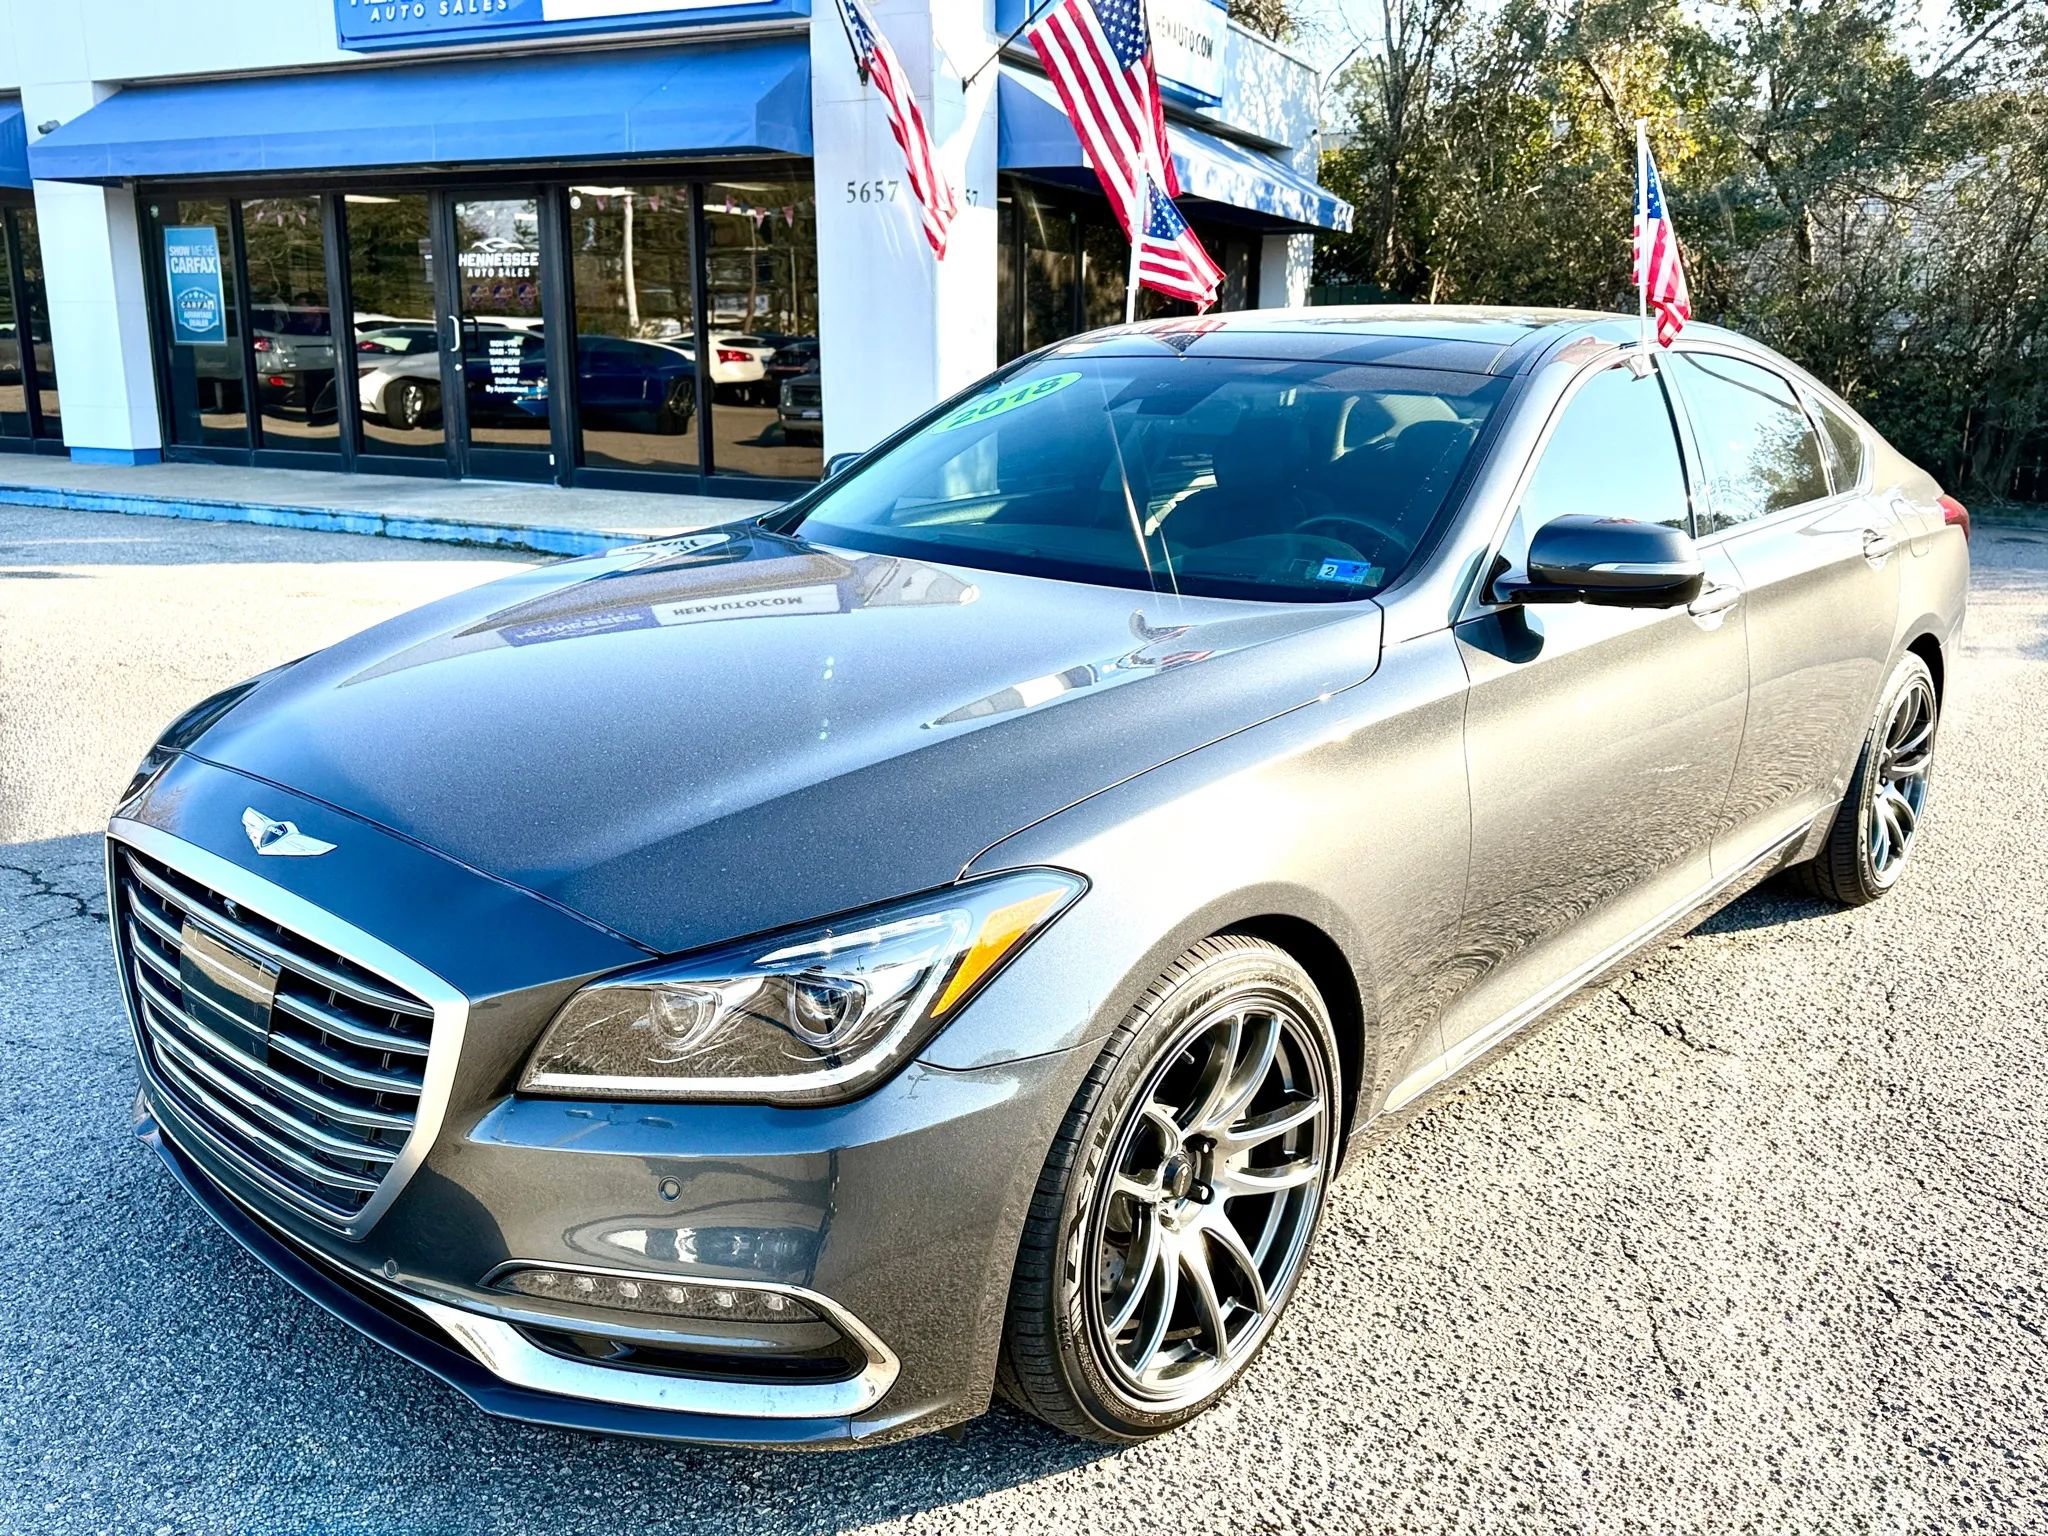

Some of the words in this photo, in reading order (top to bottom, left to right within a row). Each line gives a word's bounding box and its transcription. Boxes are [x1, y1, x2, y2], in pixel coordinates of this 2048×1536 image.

[369, 2, 426, 23] AUTO
[438, 0, 508, 17] SALES
[846, 179, 899, 203] 5657
[168, 245, 190, 257] SHOW
[170, 256, 217, 274] CARFAX
[458, 252, 540, 267] HENNESSEE
[467, 267, 495, 278] AUTO
[498, 267, 531, 278] SALES
[181, 300, 215, 310] CARFA
[946, 377, 1063, 429] 2018
[1324, 566, 1335, 577] 2
